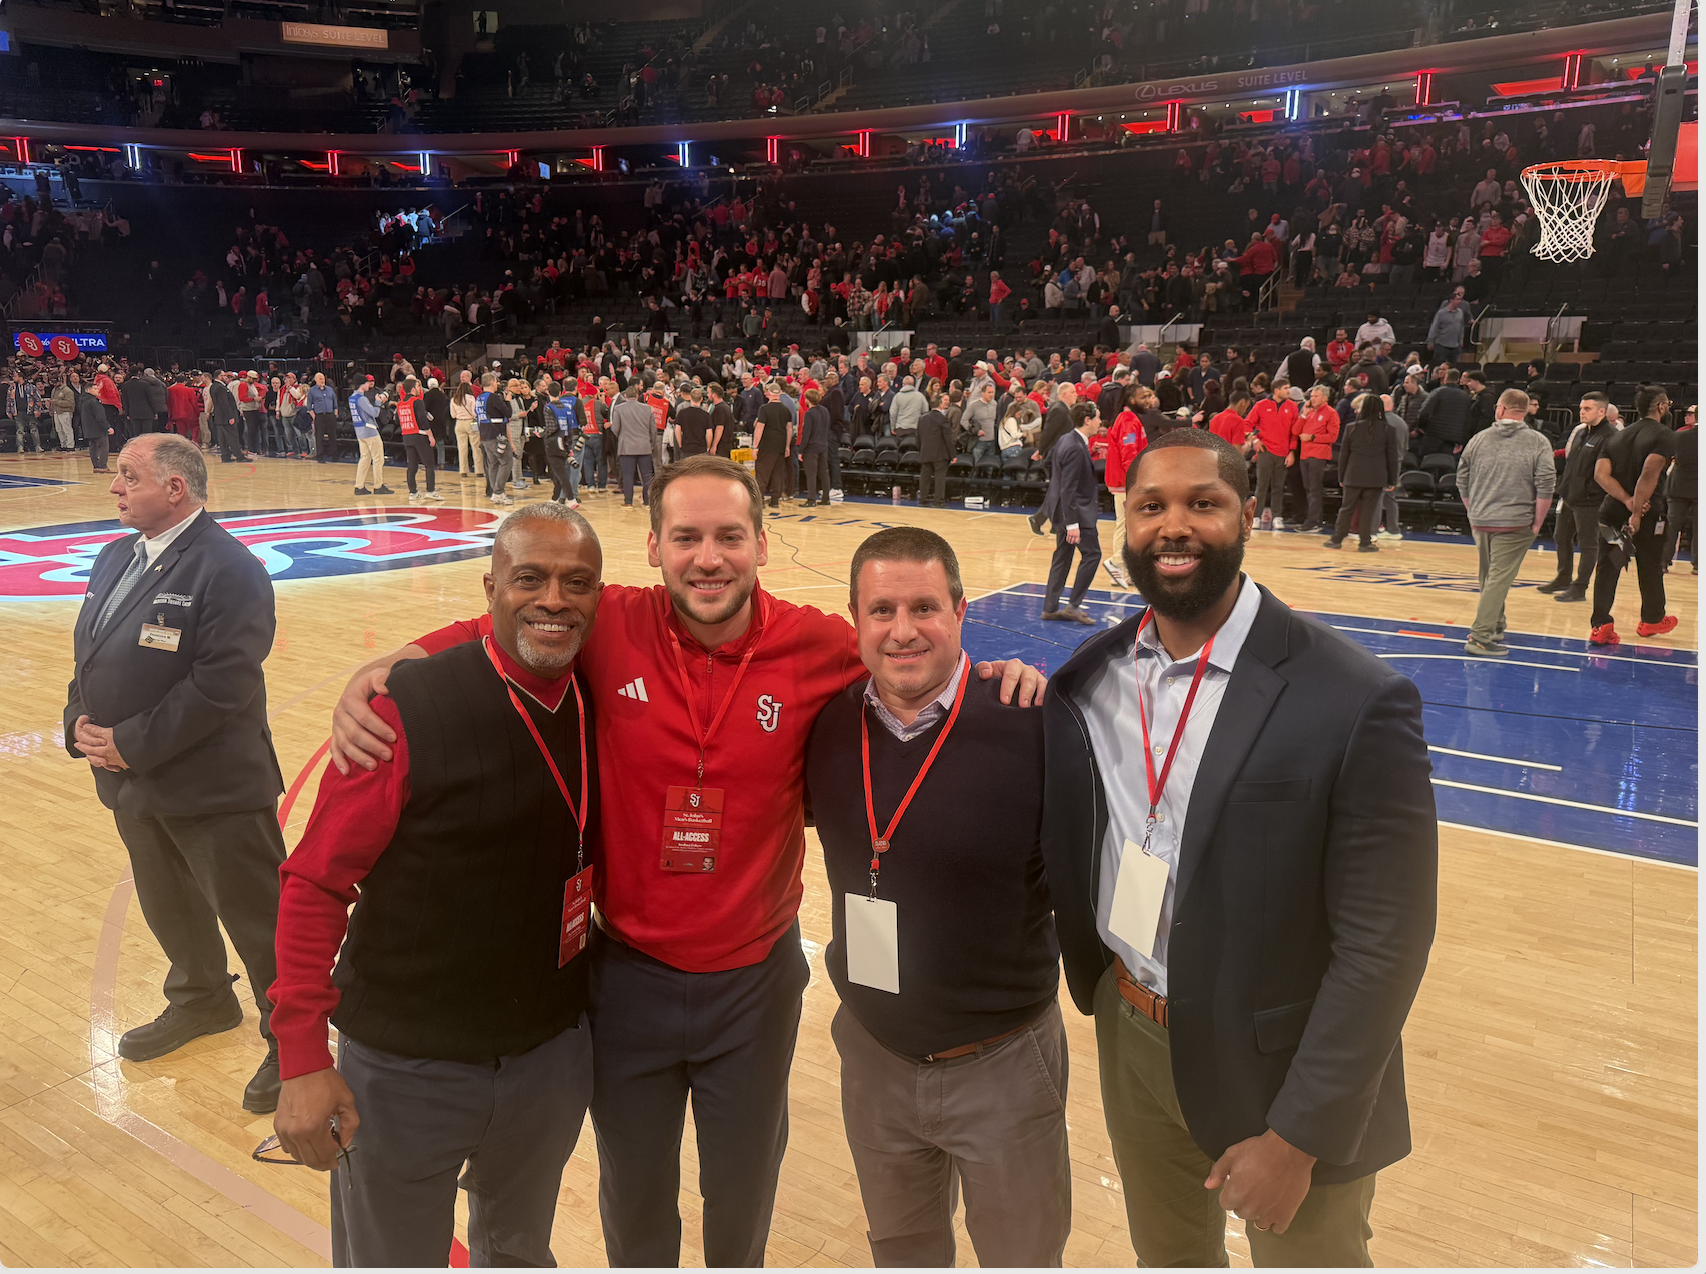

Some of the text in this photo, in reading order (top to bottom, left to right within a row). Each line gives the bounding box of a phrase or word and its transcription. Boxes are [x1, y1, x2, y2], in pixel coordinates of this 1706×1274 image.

[285, 25, 385, 43] Infosys SUITE LEVEL
[1157, 70, 1308, 96] LEXUS SUITE LEVEL
[72, 338, 106, 347] LTRA
[756, 694, 783, 733] SJ
[690, 793, 700, 807] SJ
[672, 831, 710, 842] ALL-ACCESS
